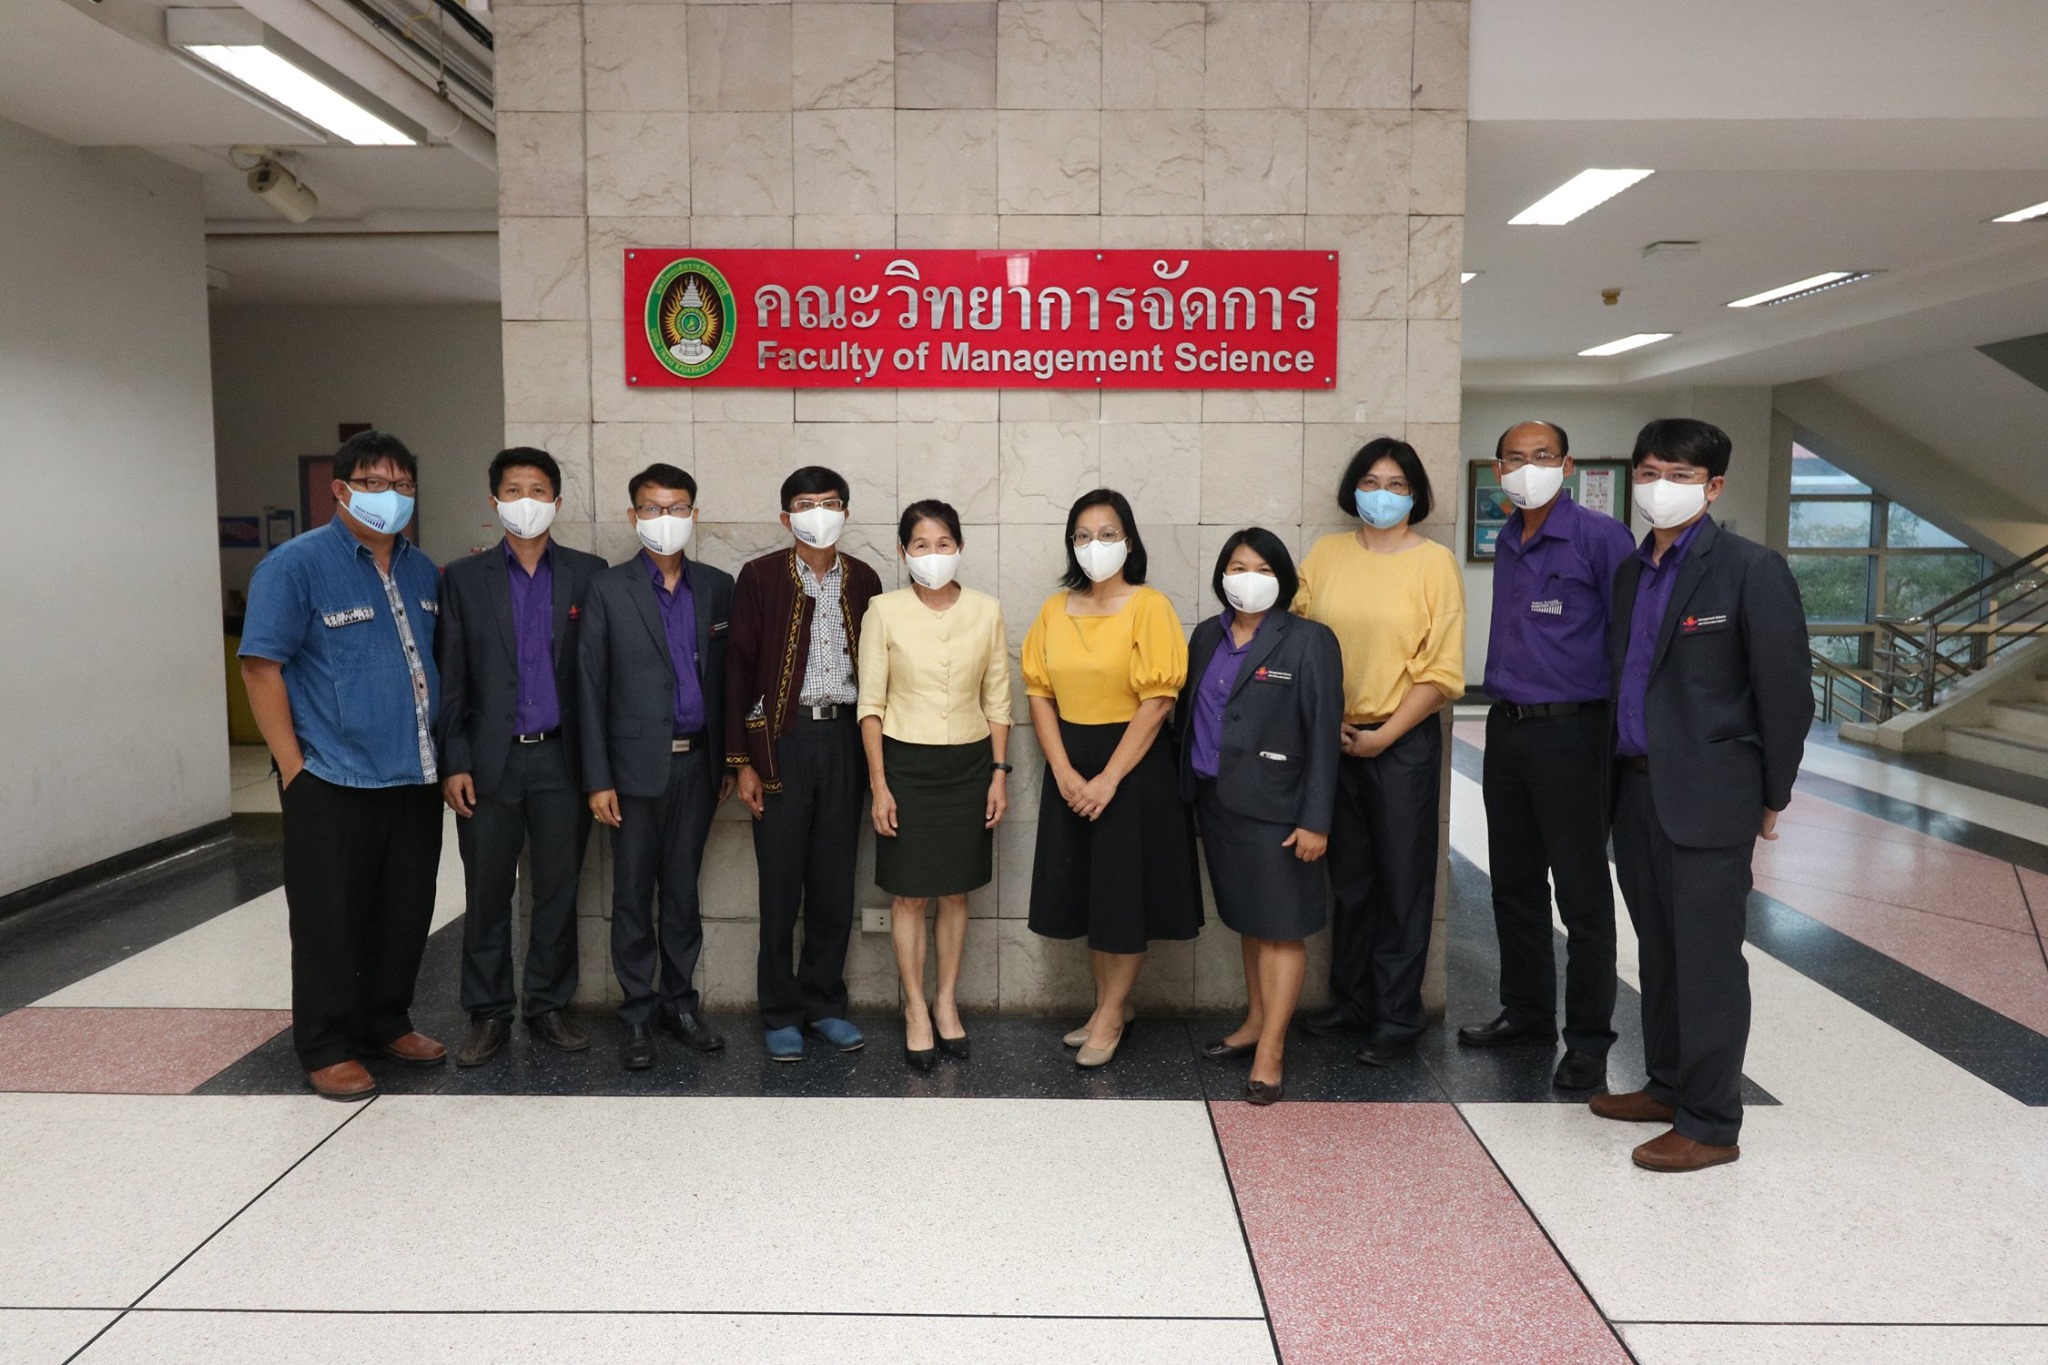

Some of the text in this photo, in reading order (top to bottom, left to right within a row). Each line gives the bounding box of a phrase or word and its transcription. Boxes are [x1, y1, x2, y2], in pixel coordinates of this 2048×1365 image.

[754, 258, 1319, 331] คณะวิทยาการจัดการ
[757, 341, 1315, 380] Faculty of Management Science
